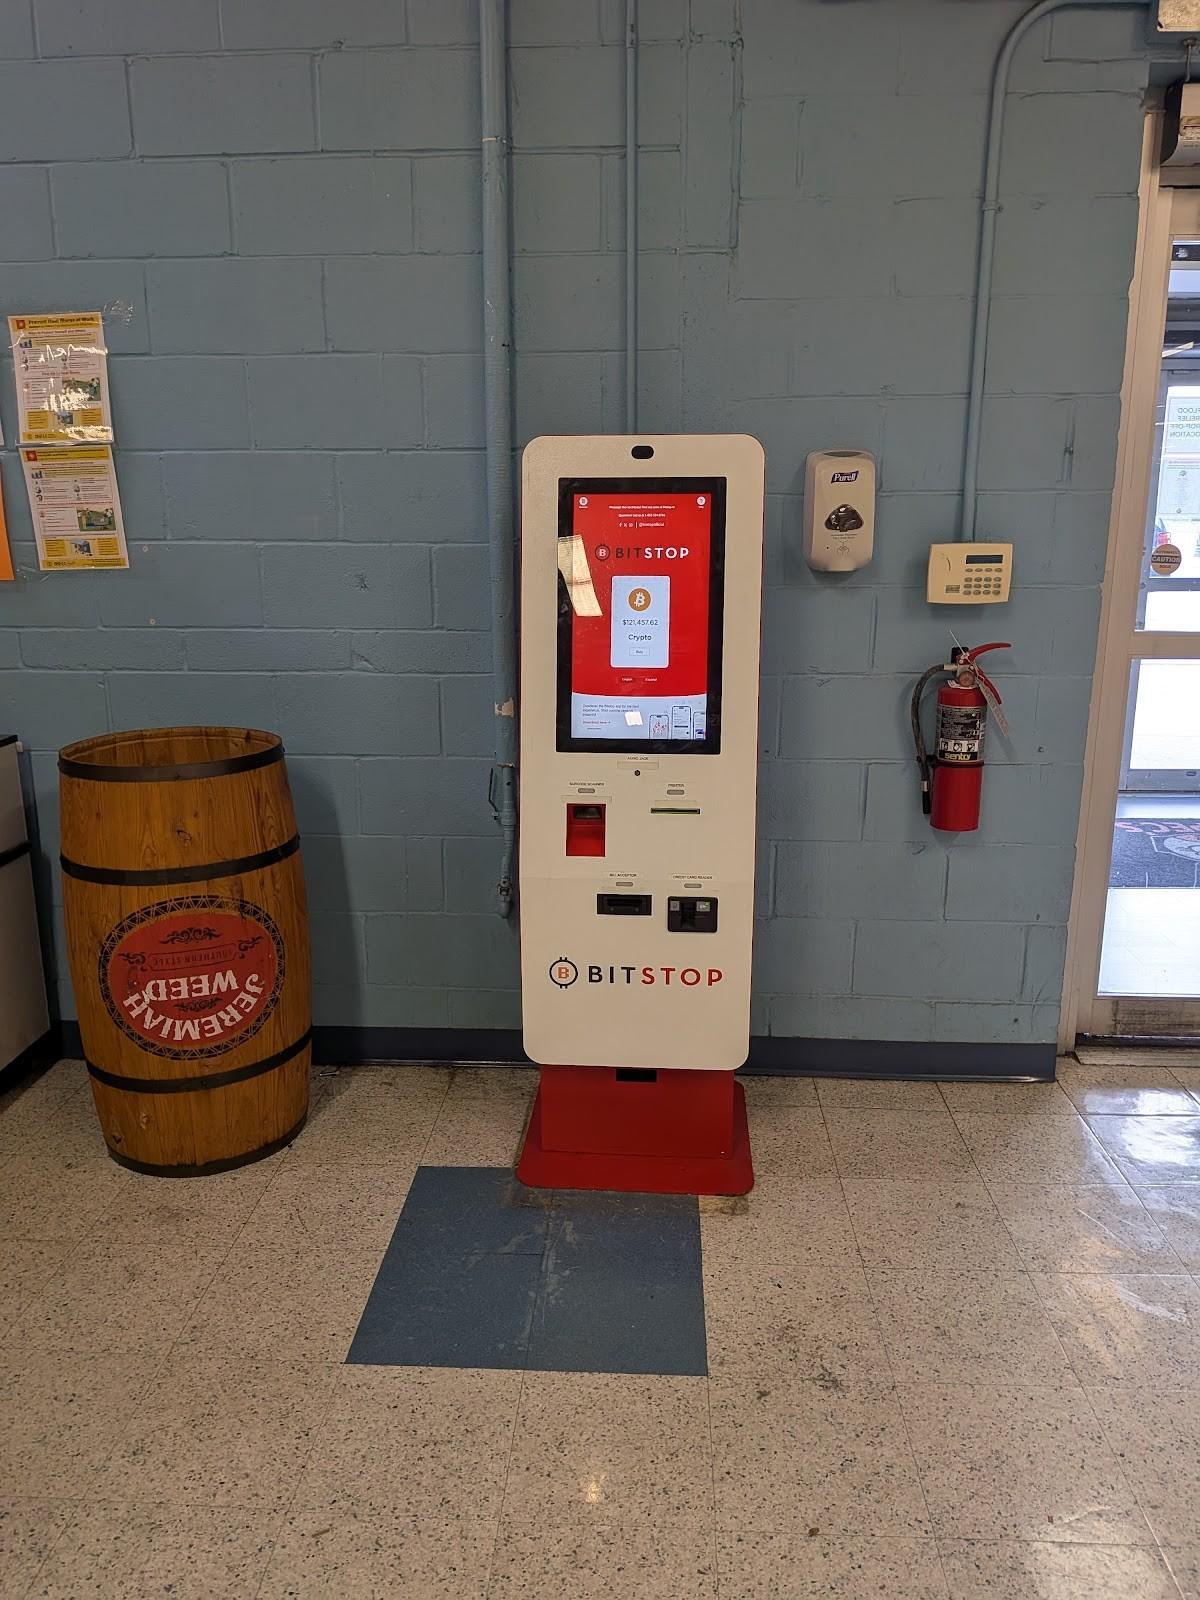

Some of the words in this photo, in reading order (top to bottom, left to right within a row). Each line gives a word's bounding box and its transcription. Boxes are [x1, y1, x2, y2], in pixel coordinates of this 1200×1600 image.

[615, 547, 689, 559] BITSTOP
[944, 752, 972, 760] Sentry
[145, 969, 240, 1001] WEED
[588, 965, 723, 987] BITSTOP
[122, 973, 264, 1040] JEREMIAH
